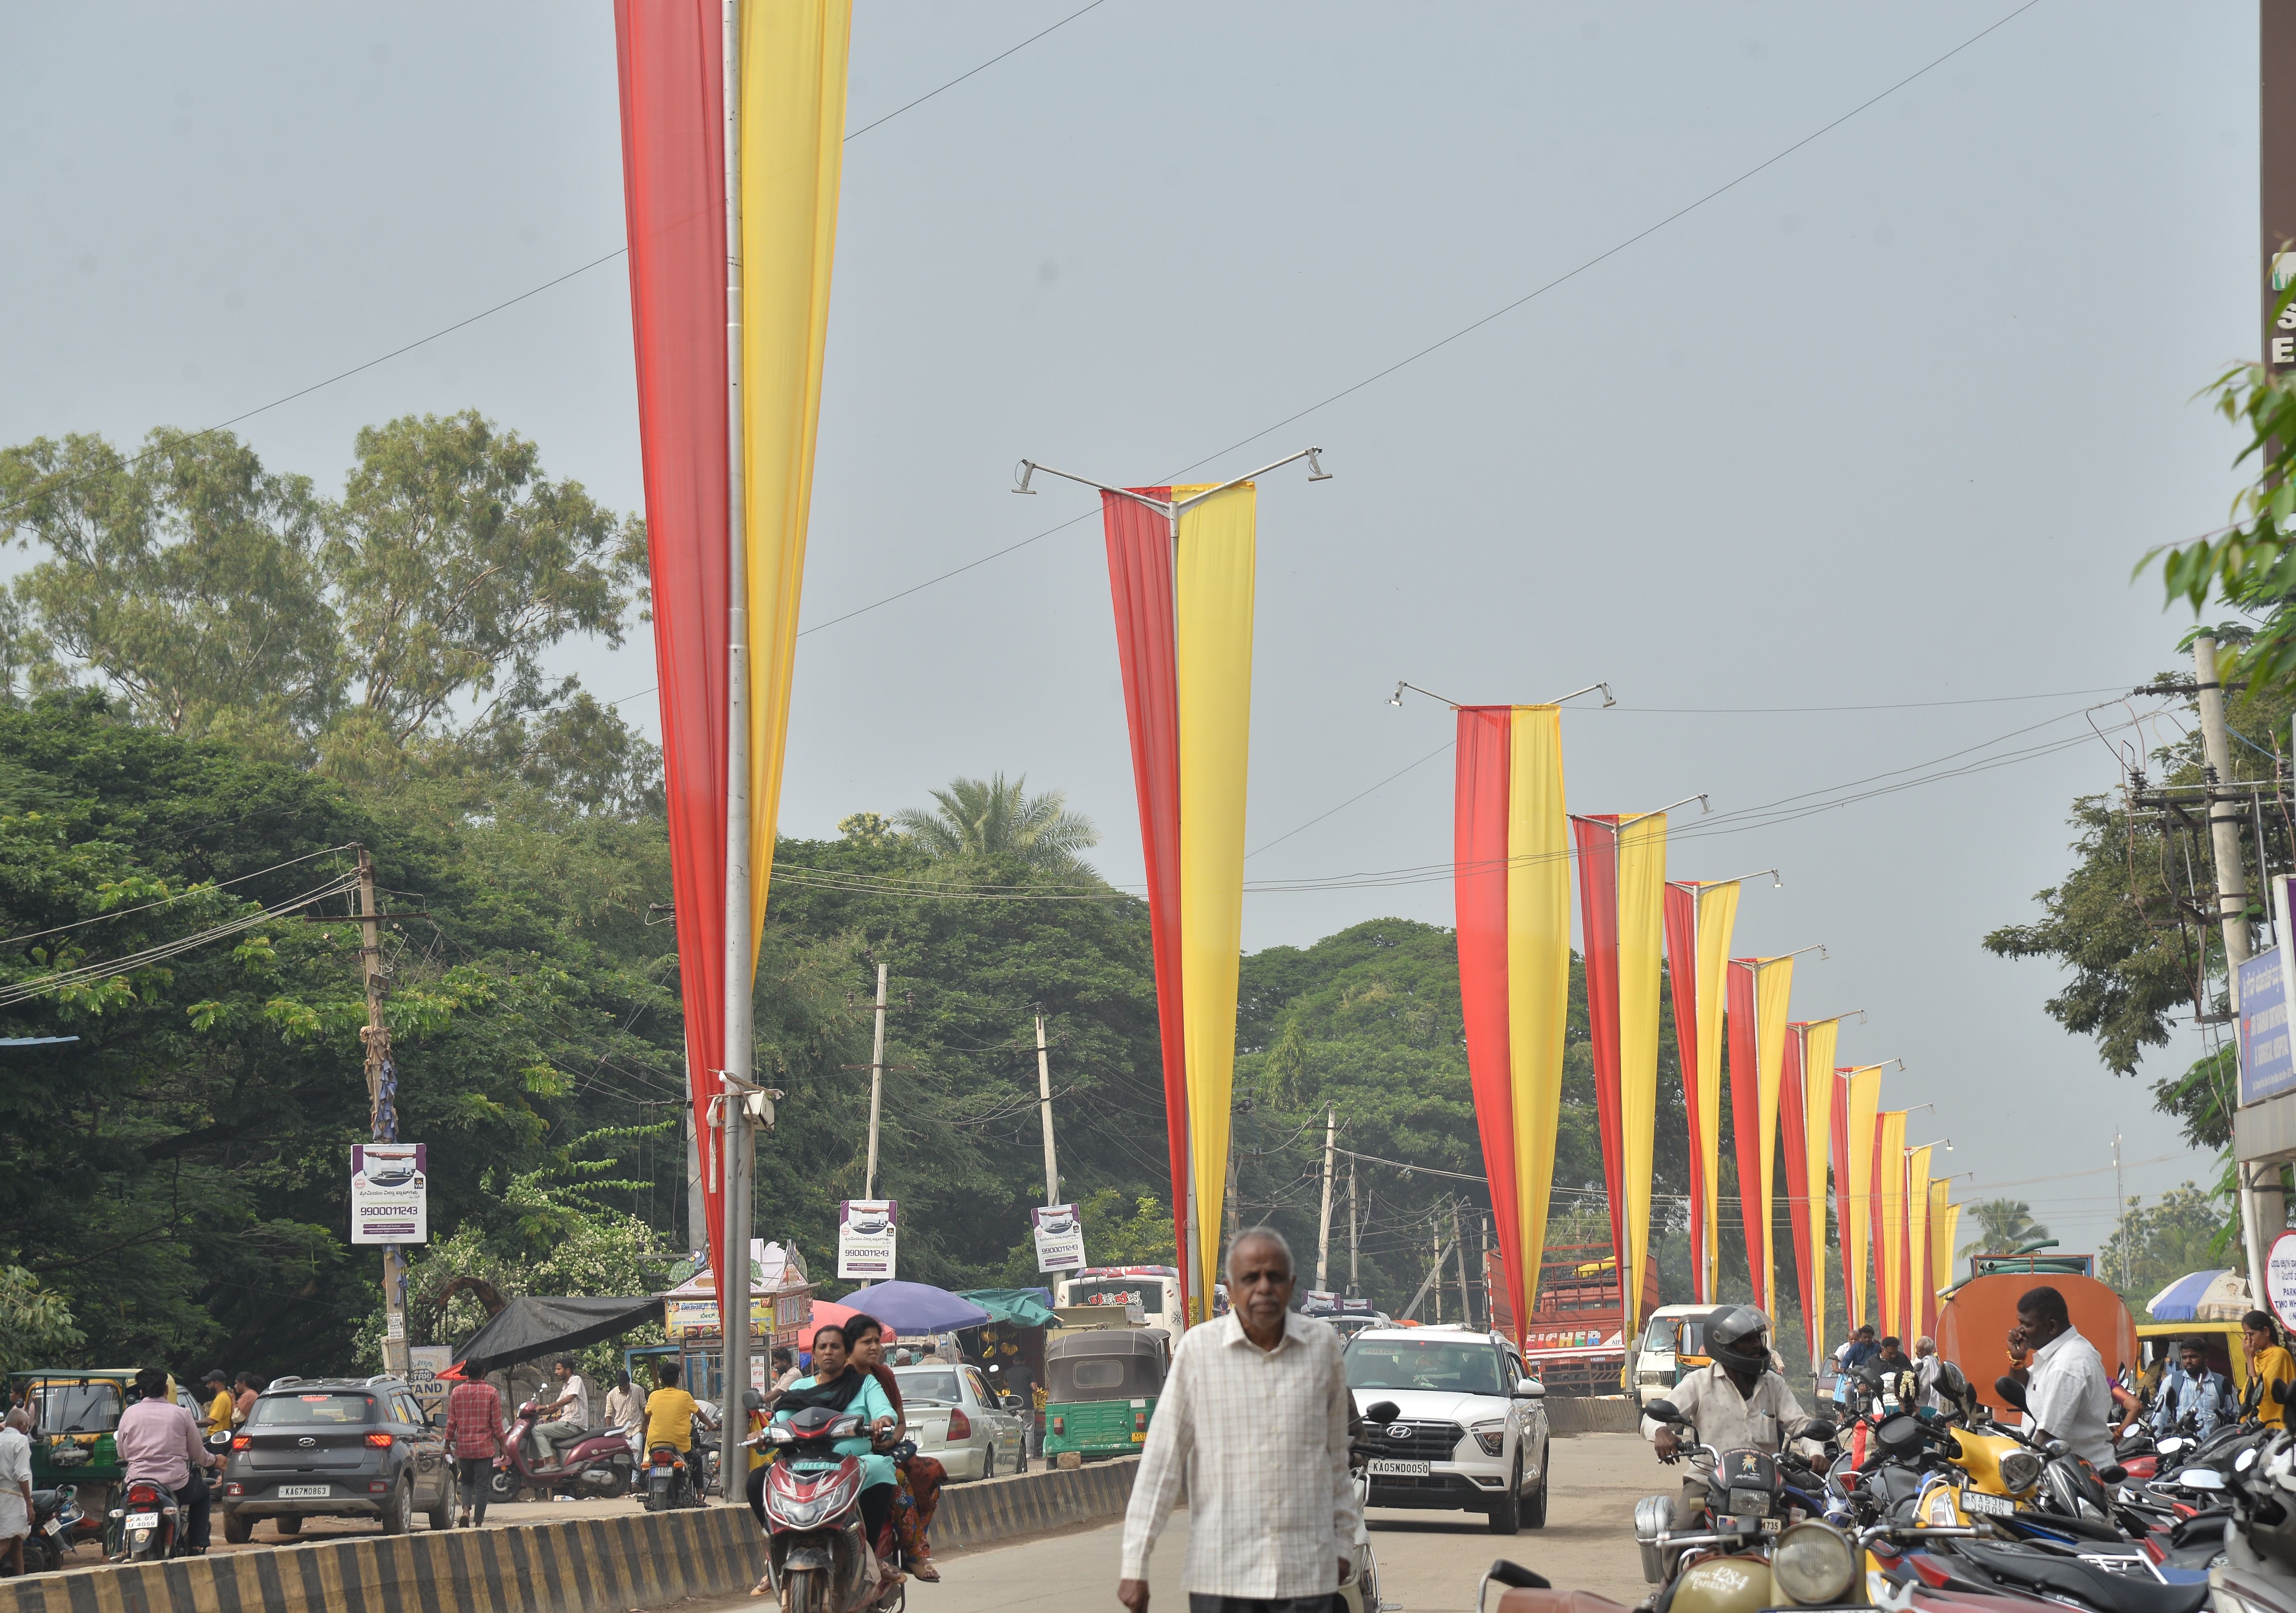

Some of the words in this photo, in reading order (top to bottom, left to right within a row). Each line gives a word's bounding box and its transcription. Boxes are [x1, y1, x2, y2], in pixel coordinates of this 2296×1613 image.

[361, 1206, 418, 1215] 9900011243
[1042, 1244, 1078, 1254] 9900011243
[1526, 1330, 1601, 1349] EICHER
[1373, 1462, 1428, 1473] KA05ND0050
[285, 1487, 326, 1495] KA67M0863
[1711, 1566, 1749, 1590] 4284
[1692, 1578, 1727, 1590] ENFIELD
